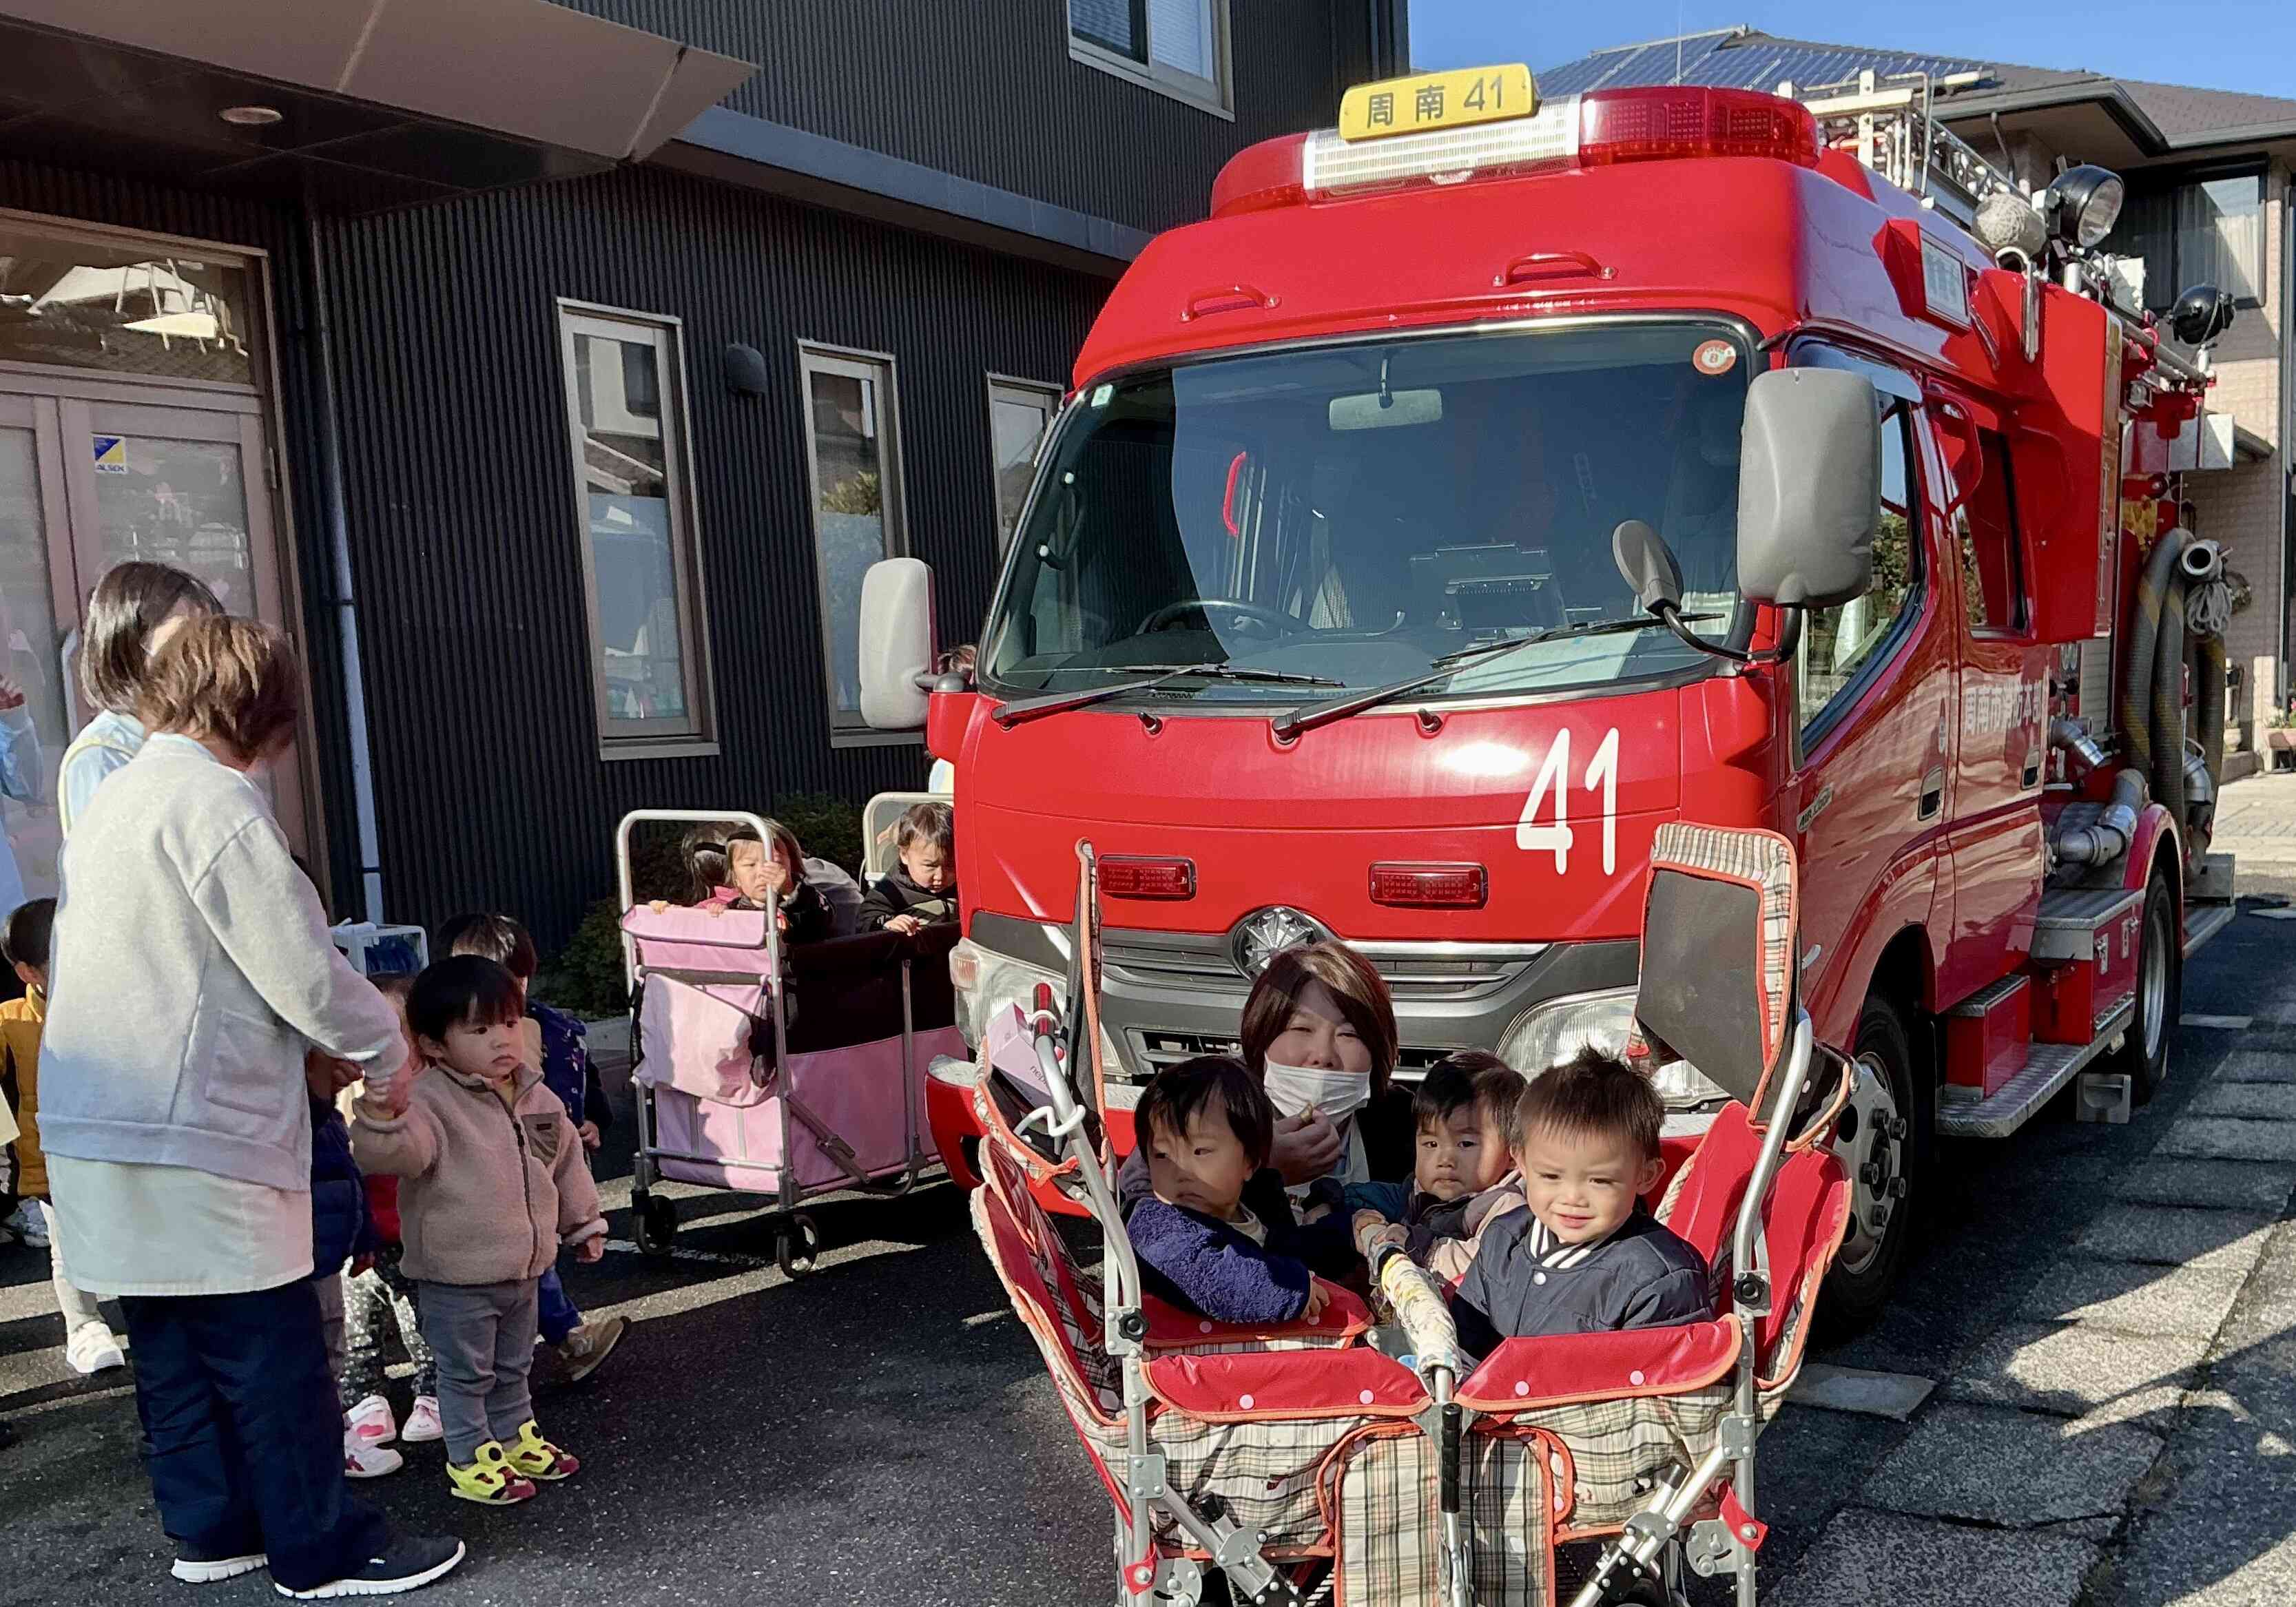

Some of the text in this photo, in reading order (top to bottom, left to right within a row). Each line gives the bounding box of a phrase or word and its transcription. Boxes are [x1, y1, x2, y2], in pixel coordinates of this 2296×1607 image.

[1367, 74, 1502, 129] 周南 41
[1516, 727, 1620, 876] 41
